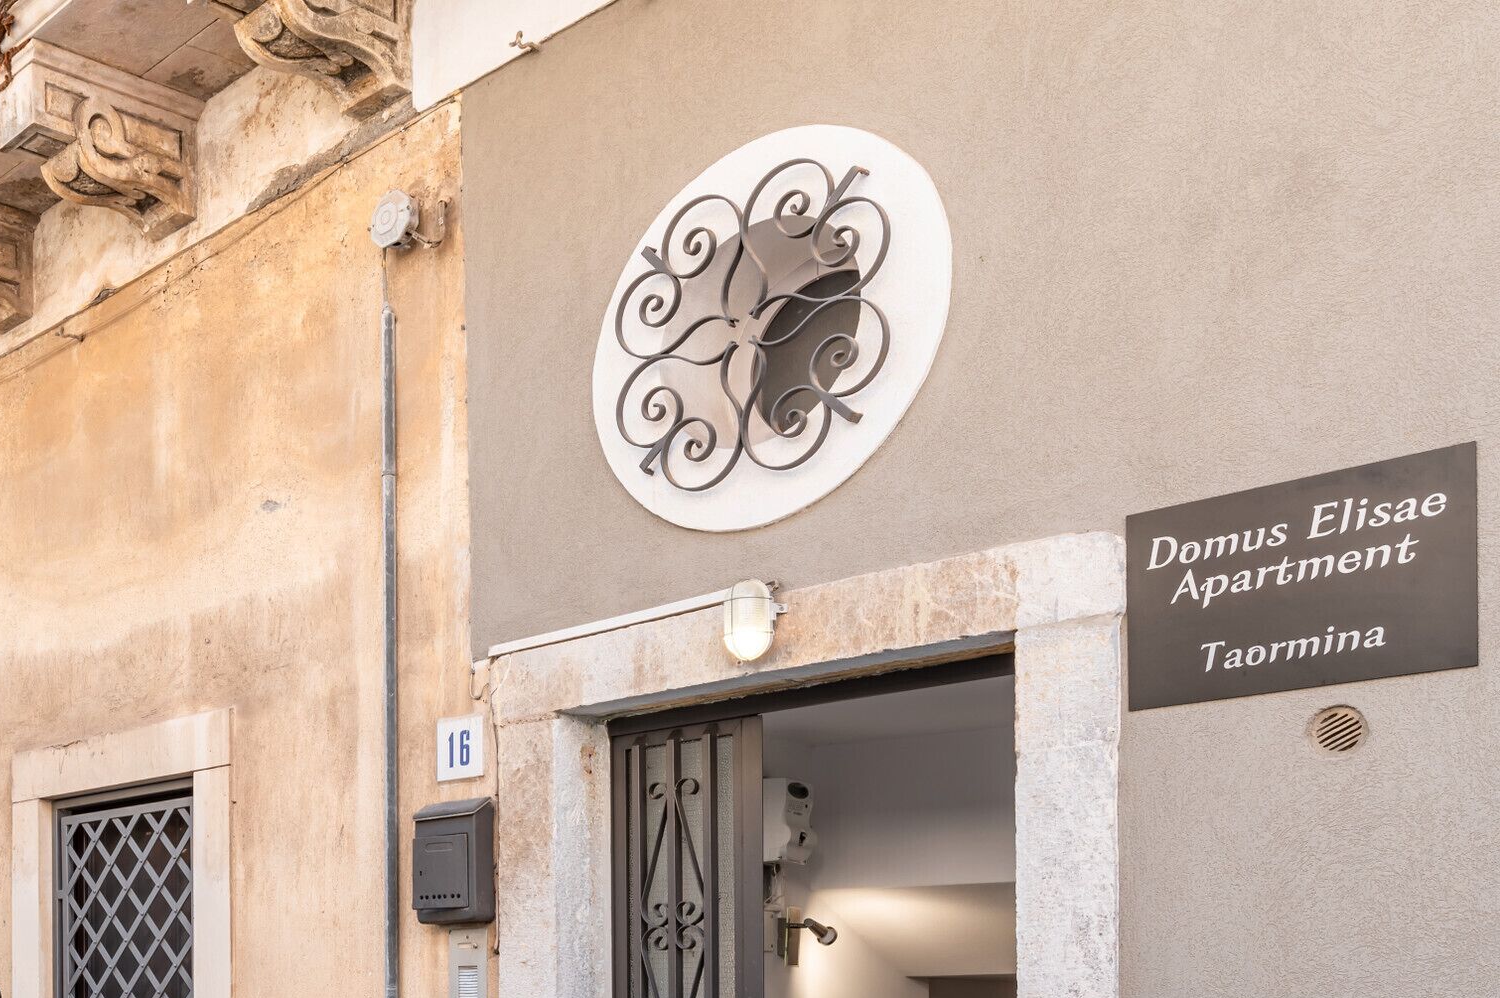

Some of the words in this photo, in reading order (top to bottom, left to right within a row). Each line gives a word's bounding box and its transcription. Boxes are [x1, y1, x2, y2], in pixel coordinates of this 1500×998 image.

[1146, 522, 1288, 570] Domus
[1307, 491, 1448, 540] Elisae
[1170, 533, 1420, 609] Apartment
[1199, 625, 1386, 673] Taormina
[448, 729, 470, 768] 16
